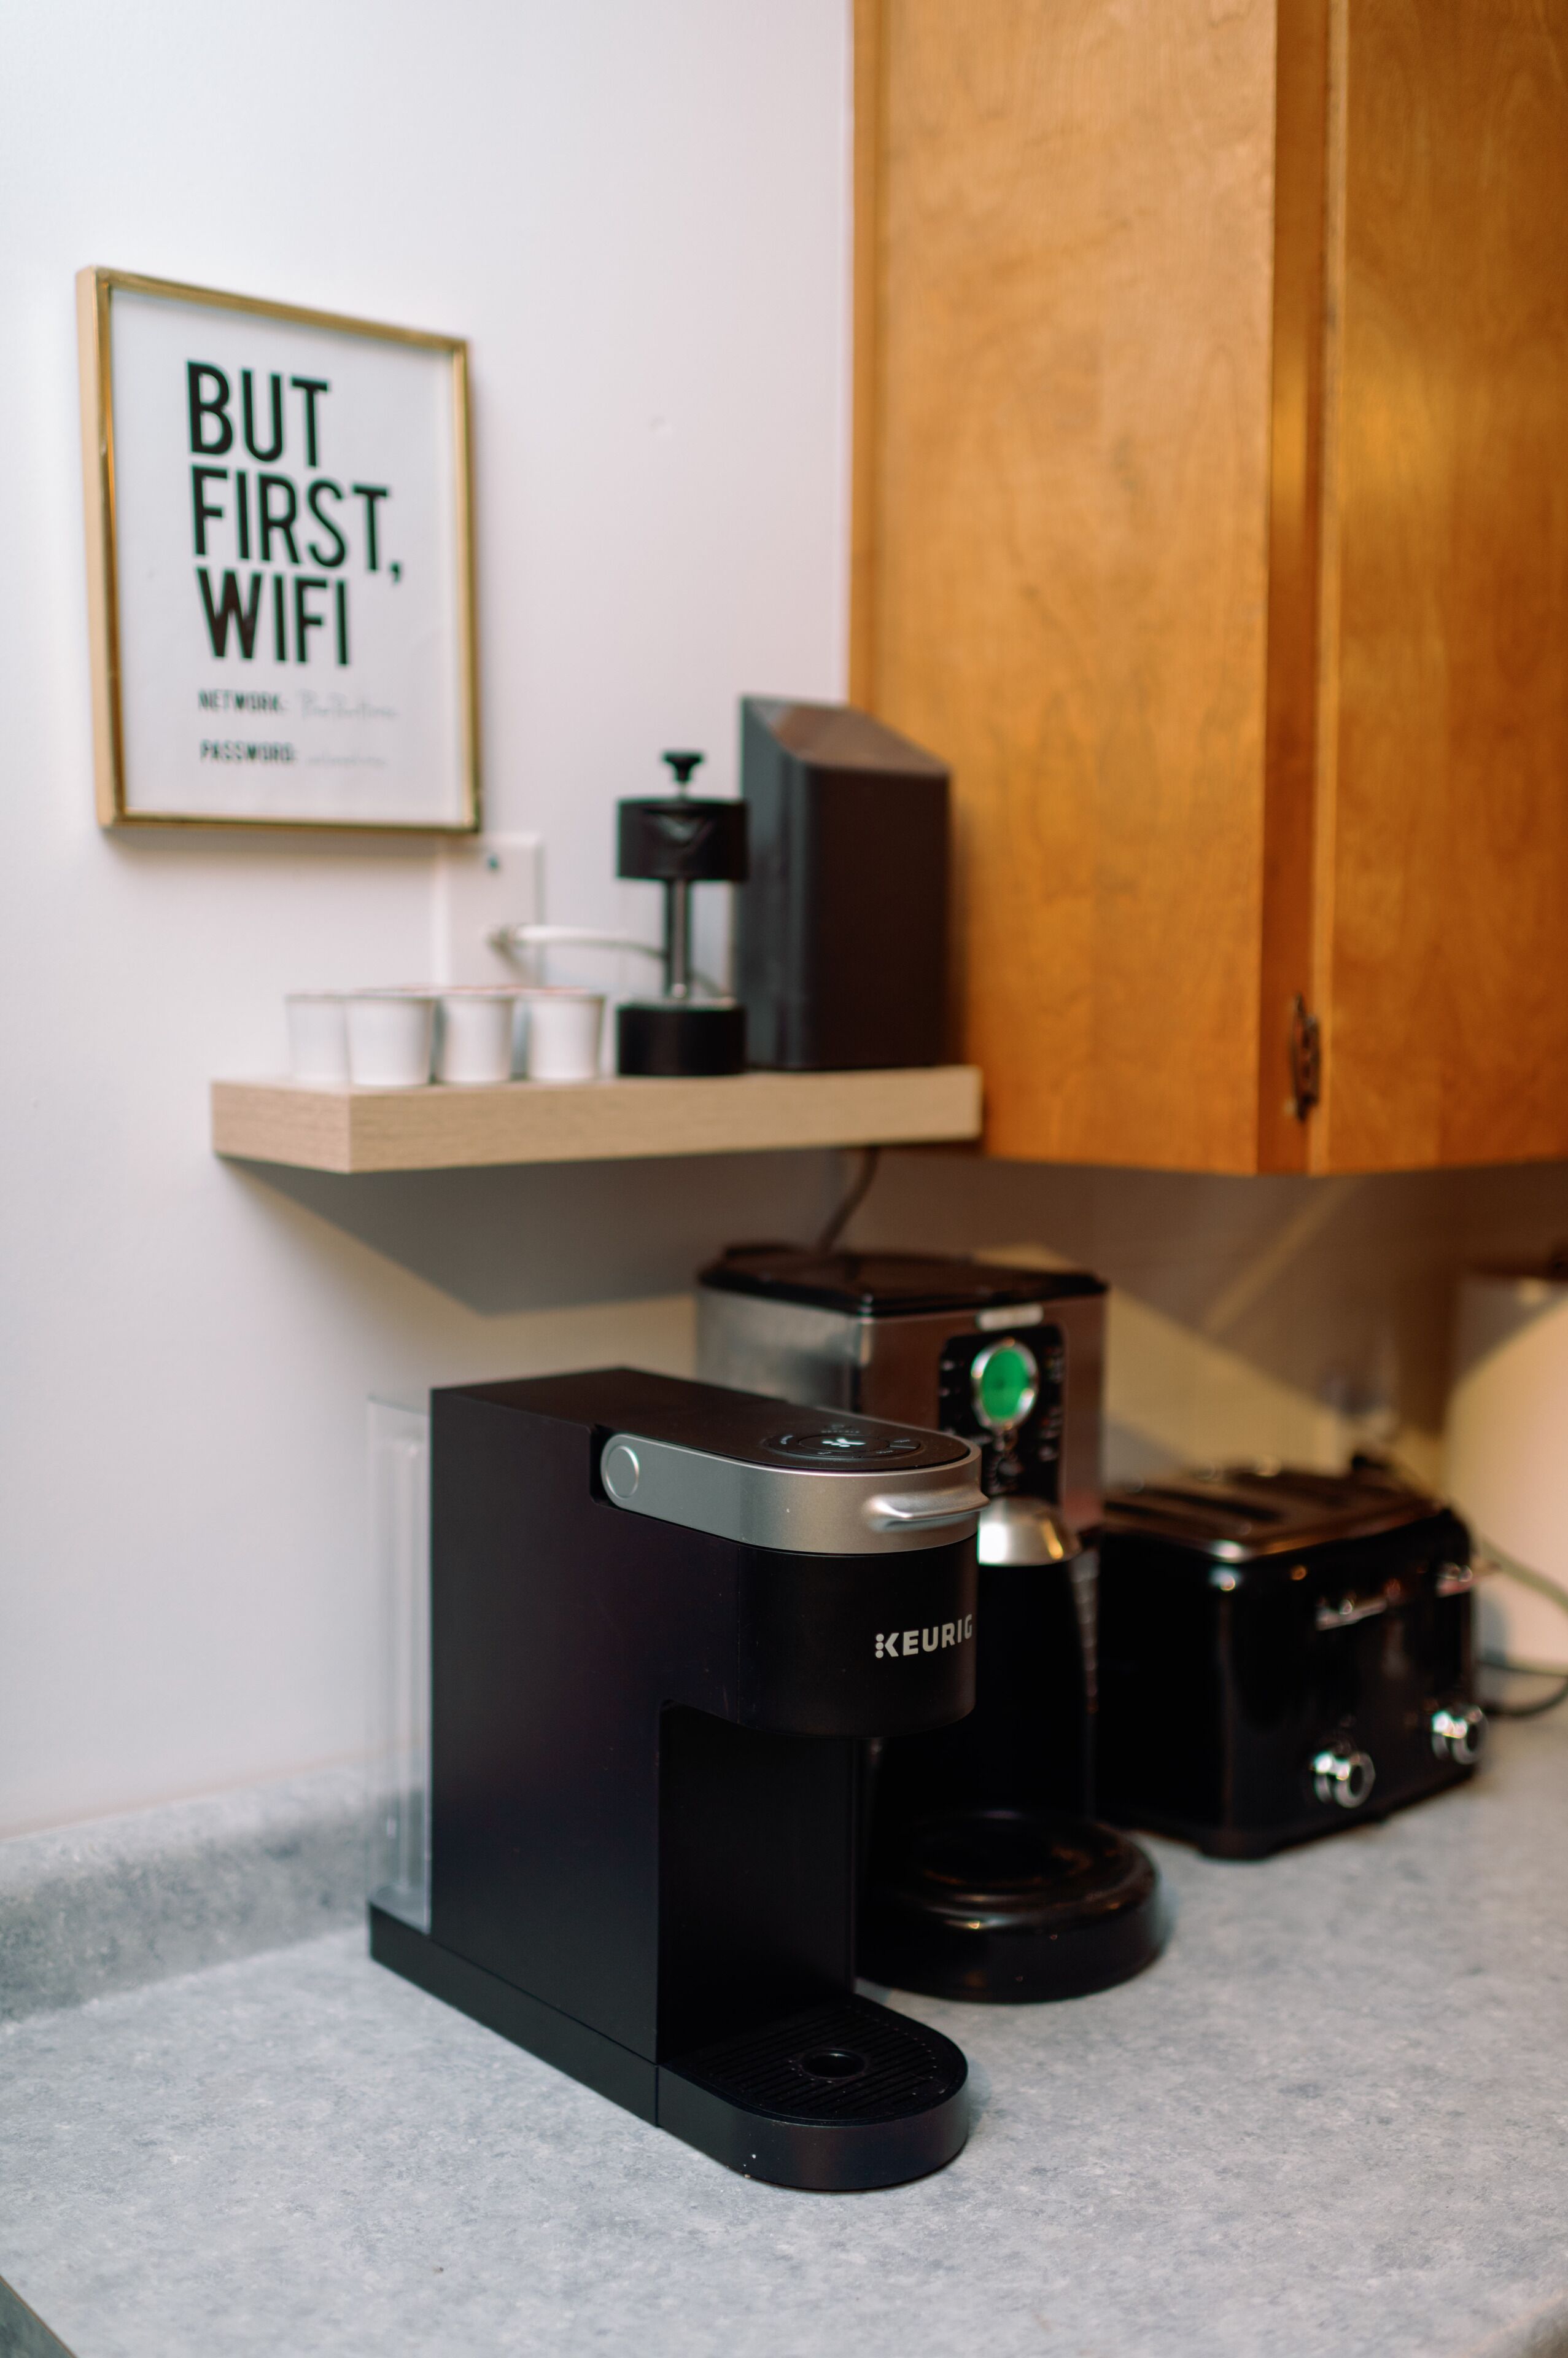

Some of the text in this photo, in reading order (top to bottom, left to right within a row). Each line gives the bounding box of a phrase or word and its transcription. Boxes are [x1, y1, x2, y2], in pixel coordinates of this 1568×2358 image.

[187, 360, 330, 468] BUT
[191, 464, 403, 585] FIRST,
[195, 566, 350, 667] WIFI
[875, 1614, 972, 1659] KEURIG
